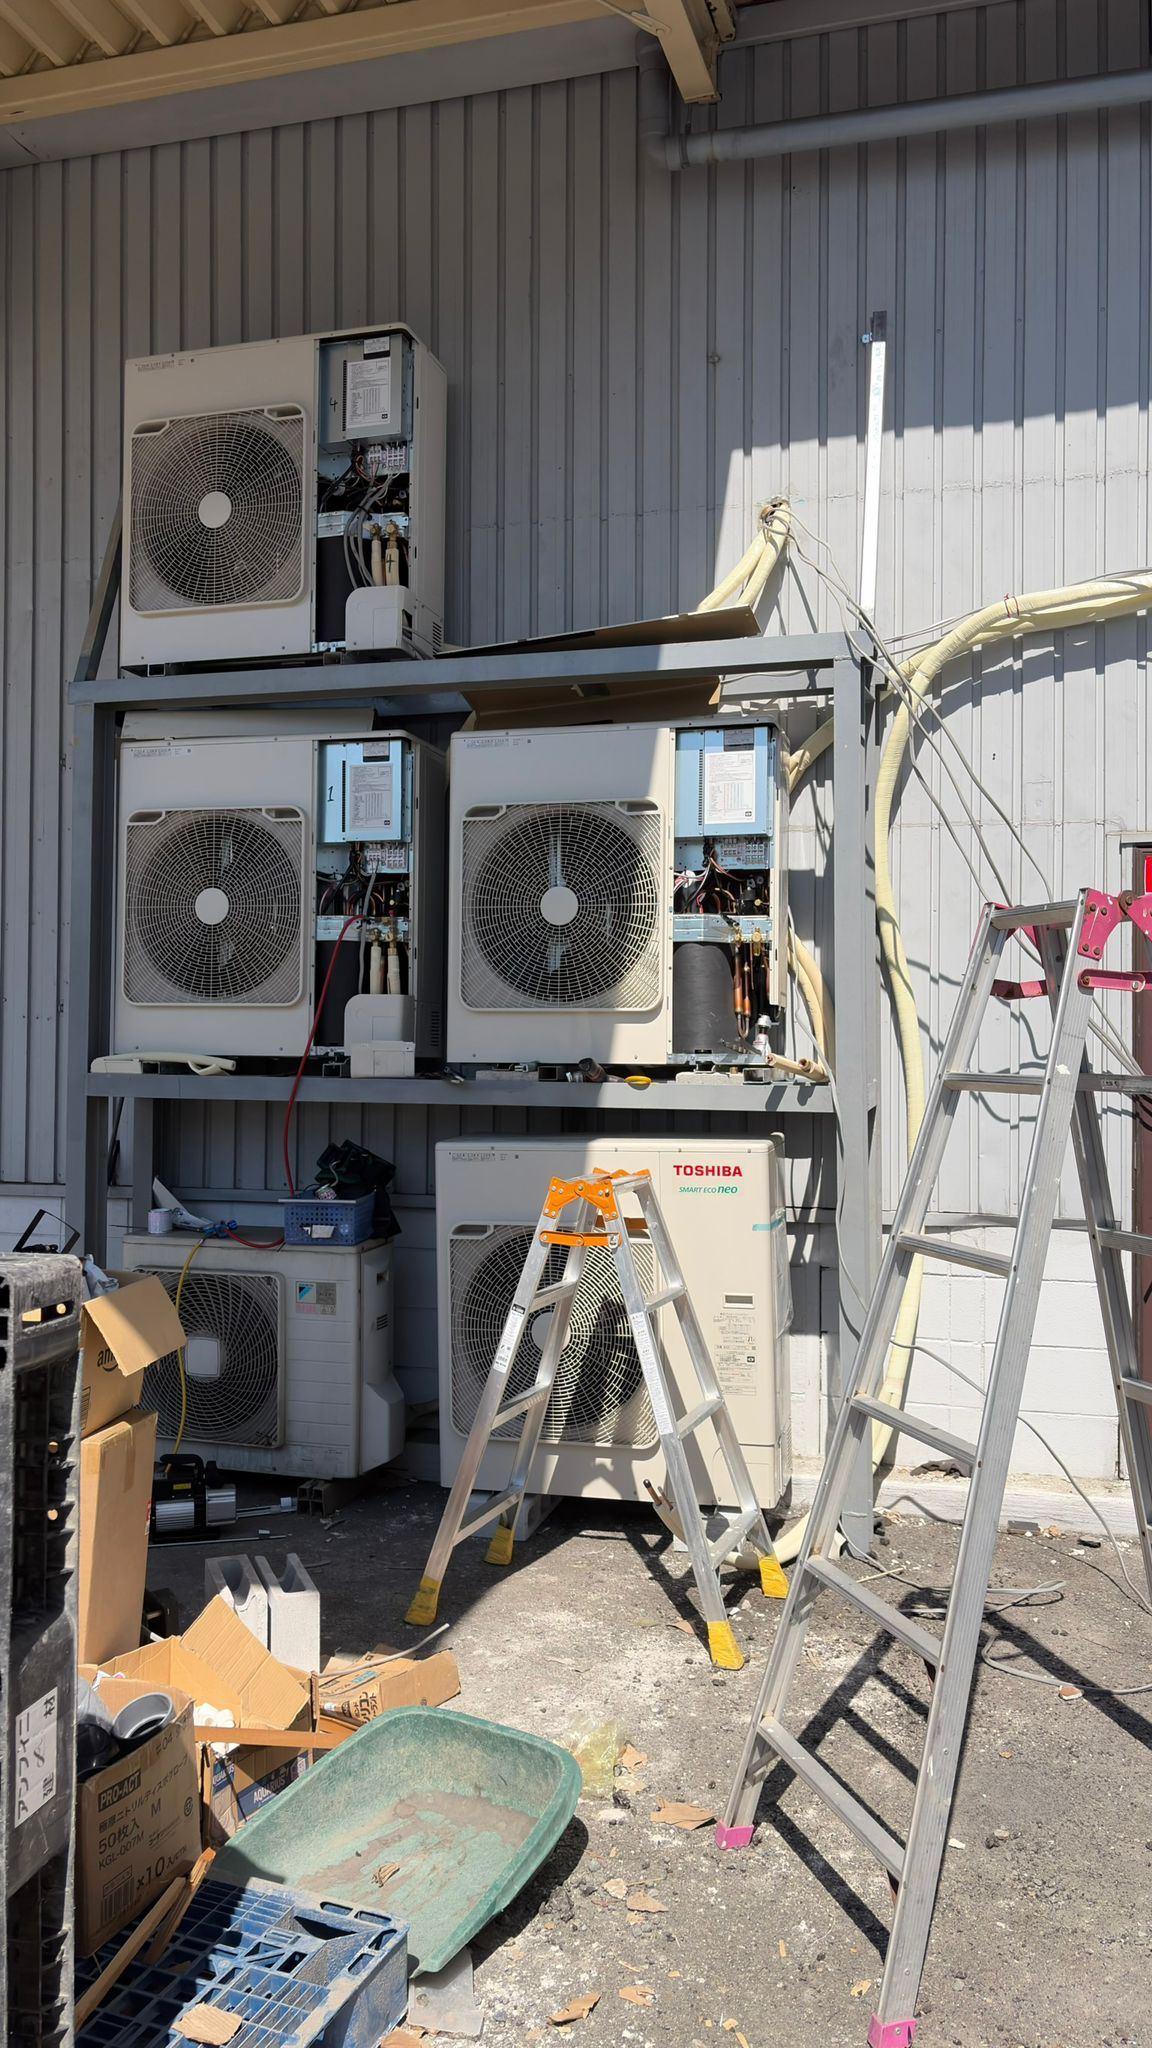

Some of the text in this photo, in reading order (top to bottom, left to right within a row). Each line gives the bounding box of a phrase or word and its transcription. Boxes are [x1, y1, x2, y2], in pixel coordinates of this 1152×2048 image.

[327, 785, 335, 802] 1
[673, 1164, 743, 1177] TOSHIBA
[717, 1185, 738, 1194] neo
[97, 1348, 115, 1367] am
[17, 1711, 30, 1820] アンフィニ
[100, 1771, 141, 1809] PRO-ACT
[253, 1775, 287, 1804] AQUARIUS
[150, 1799, 162, 1817] M
[98, 1816, 140, 1855] 50枚入
[98, 1830, 145, 1871] KGL-007M
